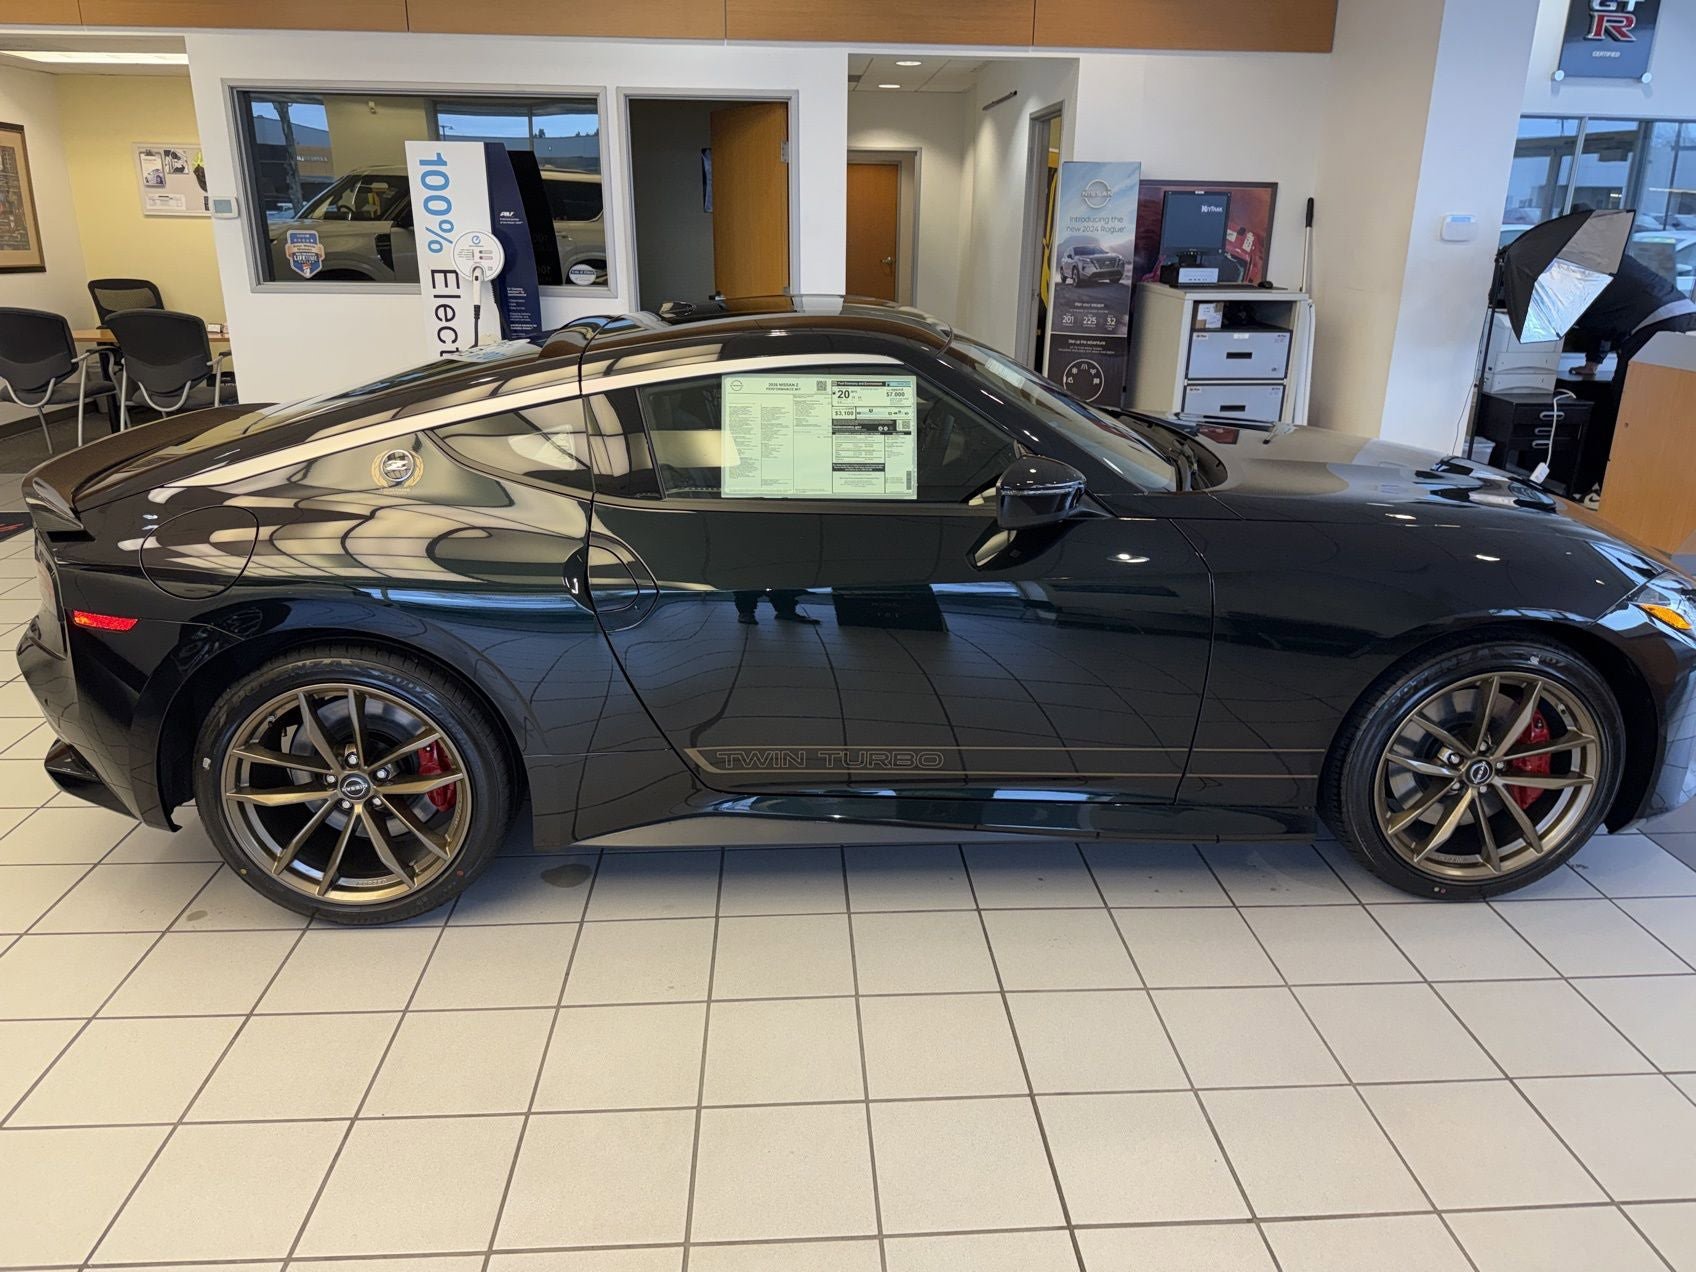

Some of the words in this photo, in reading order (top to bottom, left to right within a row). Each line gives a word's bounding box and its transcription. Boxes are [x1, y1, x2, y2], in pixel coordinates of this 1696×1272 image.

[1584, 12, 1637, 41] R
[1592, 50, 1621, 58] CERTIFIED
[418, 152, 455, 254] 100%
[1069, 215, 1110, 225] Introducing
[1111, 216, 1124, 224] the
[1082, 225, 1099, 233] 2024
[1062, 315, 1074, 323] 201
[1083, 316, 1097, 325] 225
[1106, 317, 1117, 326] 32
[837, 389, 850, 399] 20
[716, 750, 806, 769] TWIN
[818, 750, 945, 769] TURBO
